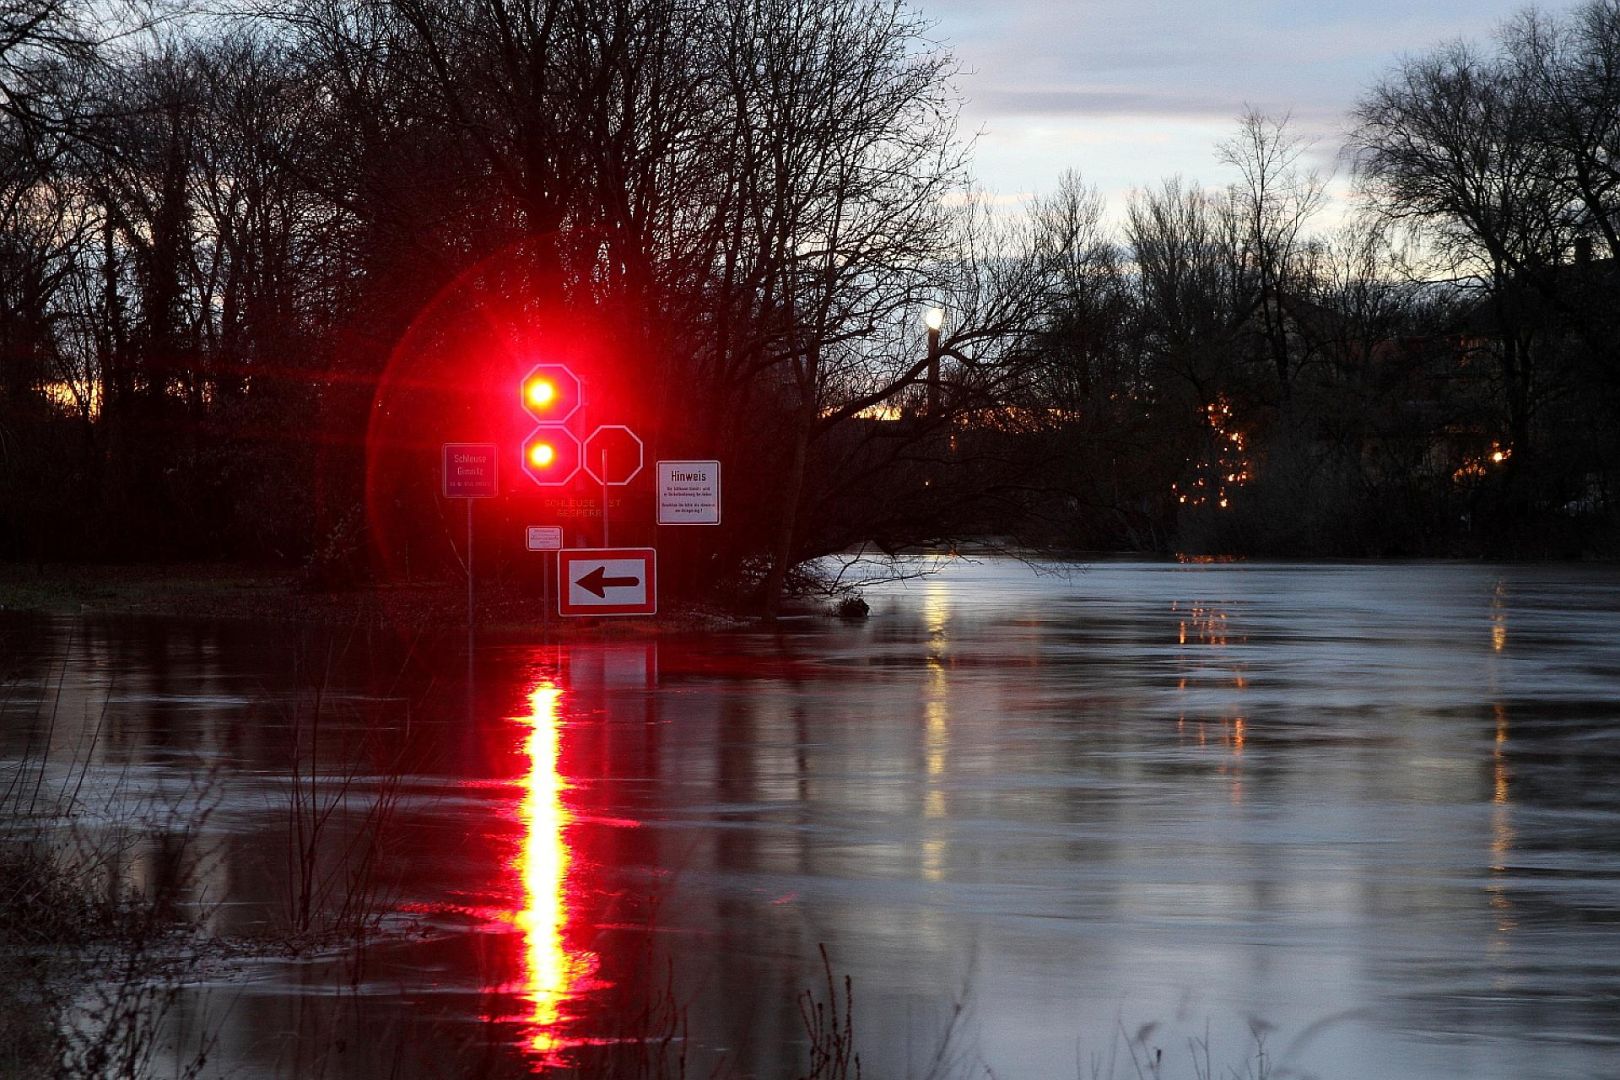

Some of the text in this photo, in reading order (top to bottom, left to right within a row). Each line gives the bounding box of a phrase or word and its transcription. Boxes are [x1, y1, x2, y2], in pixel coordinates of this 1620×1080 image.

[454, 454, 487, 463] Schleuse
[671, 471, 707, 482] Hinweis
[557, 508, 607, 518] GESPERR
